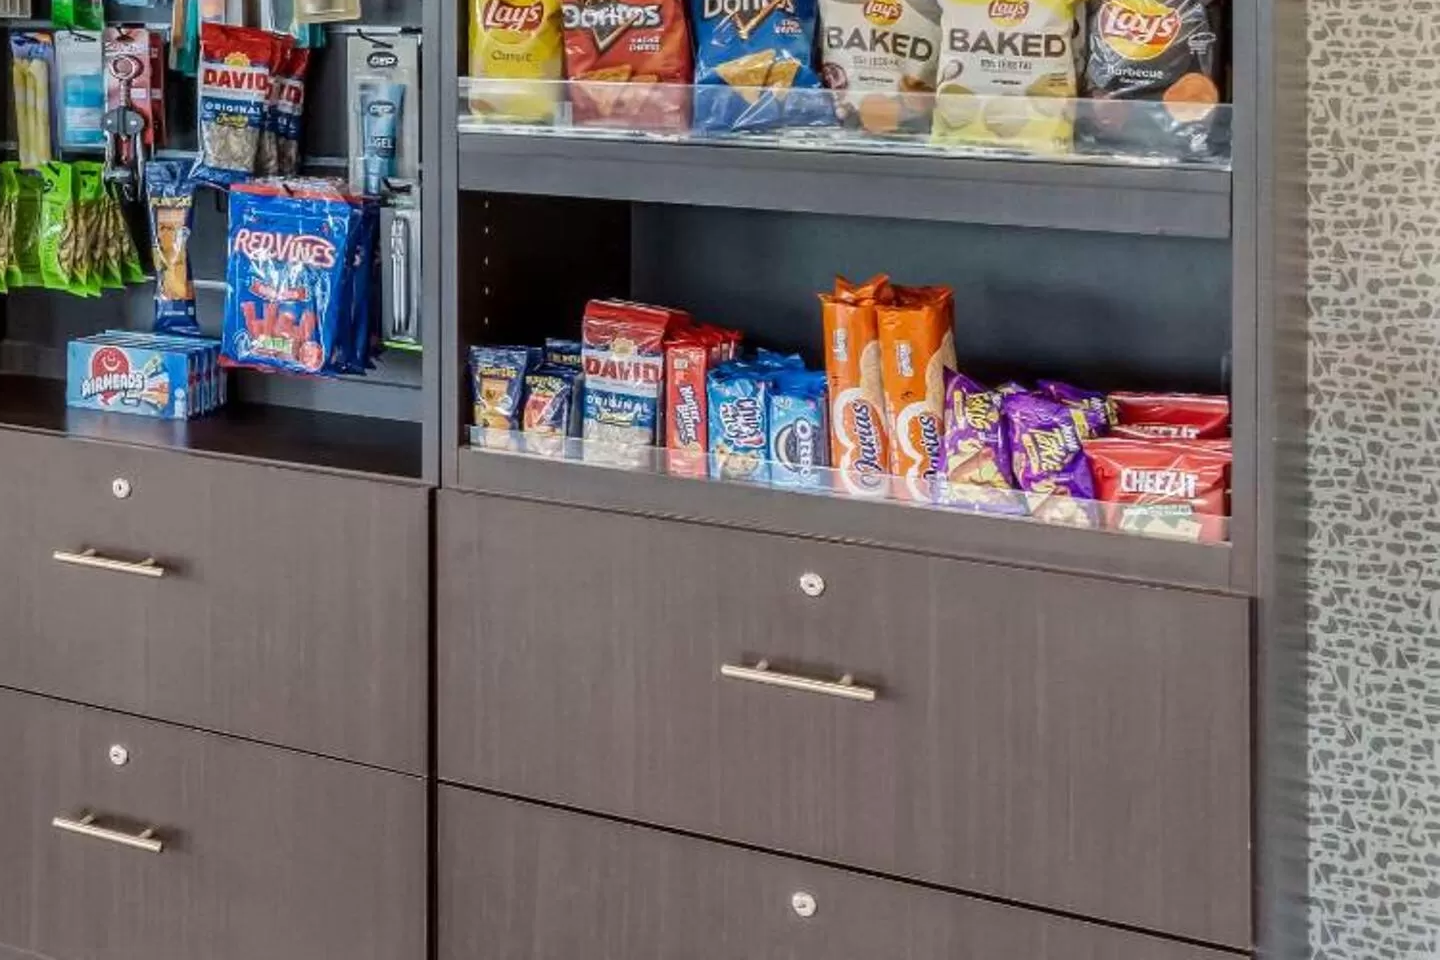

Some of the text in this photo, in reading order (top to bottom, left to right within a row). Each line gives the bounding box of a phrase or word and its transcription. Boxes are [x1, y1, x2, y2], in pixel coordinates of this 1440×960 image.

[564, 0, 661, 30] Doritos
[1101, 4, 1182, 50] Lay's
[826, 25, 933, 62] BAKED
[949, 26, 1067, 58] BAKED
[203, 67, 268, 91] DAVID
[234, 227, 337, 269] RED VINES
[82, 370, 145, 399] AIRHEADS
[585, 357, 661, 381] DAVID
[586, 392, 650, 412] ORIGINAL
[794, 420, 813, 477] OREO
